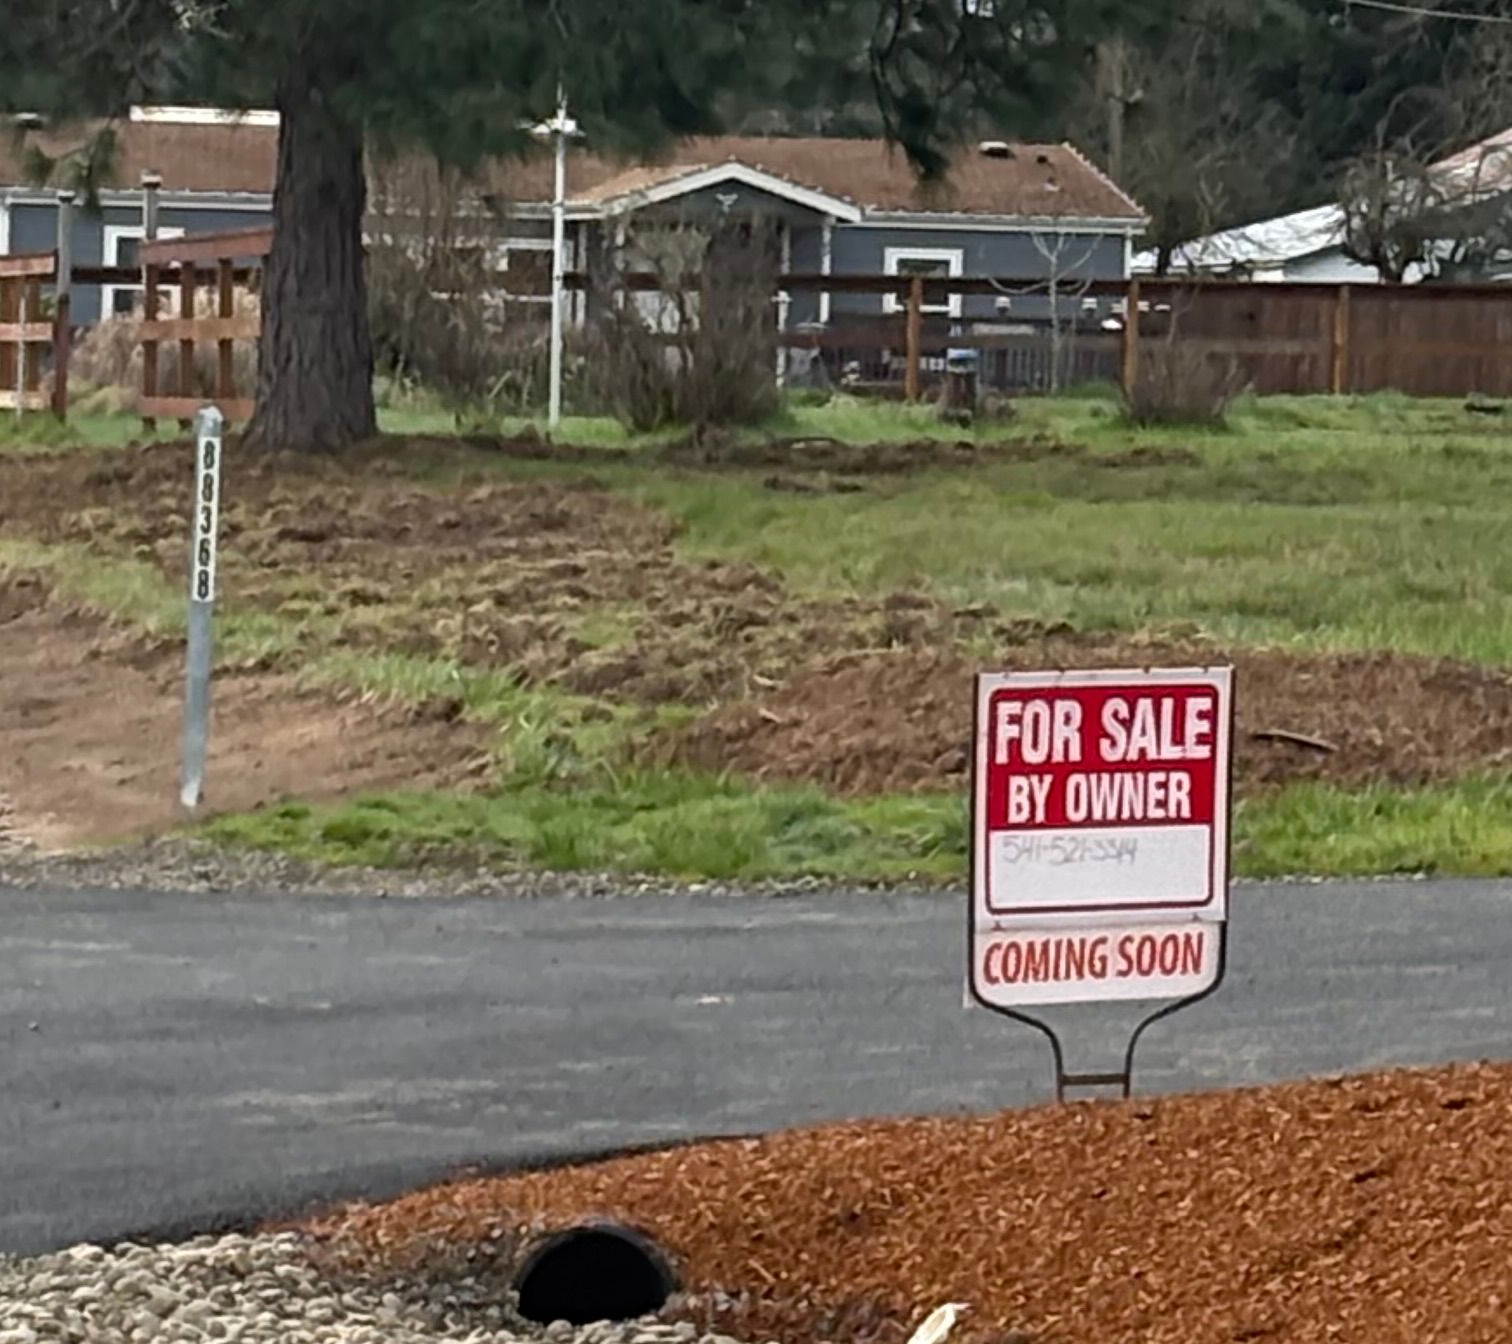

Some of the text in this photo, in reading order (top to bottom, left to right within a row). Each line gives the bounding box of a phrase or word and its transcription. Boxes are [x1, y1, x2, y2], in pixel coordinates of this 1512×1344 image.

[197, 440, 216, 599] 88368
[995, 697, 1213, 765] FOR SALE
[1007, 771, 1192, 824] BY OWNER
[983, 932, 1204, 984] COMING SOON
